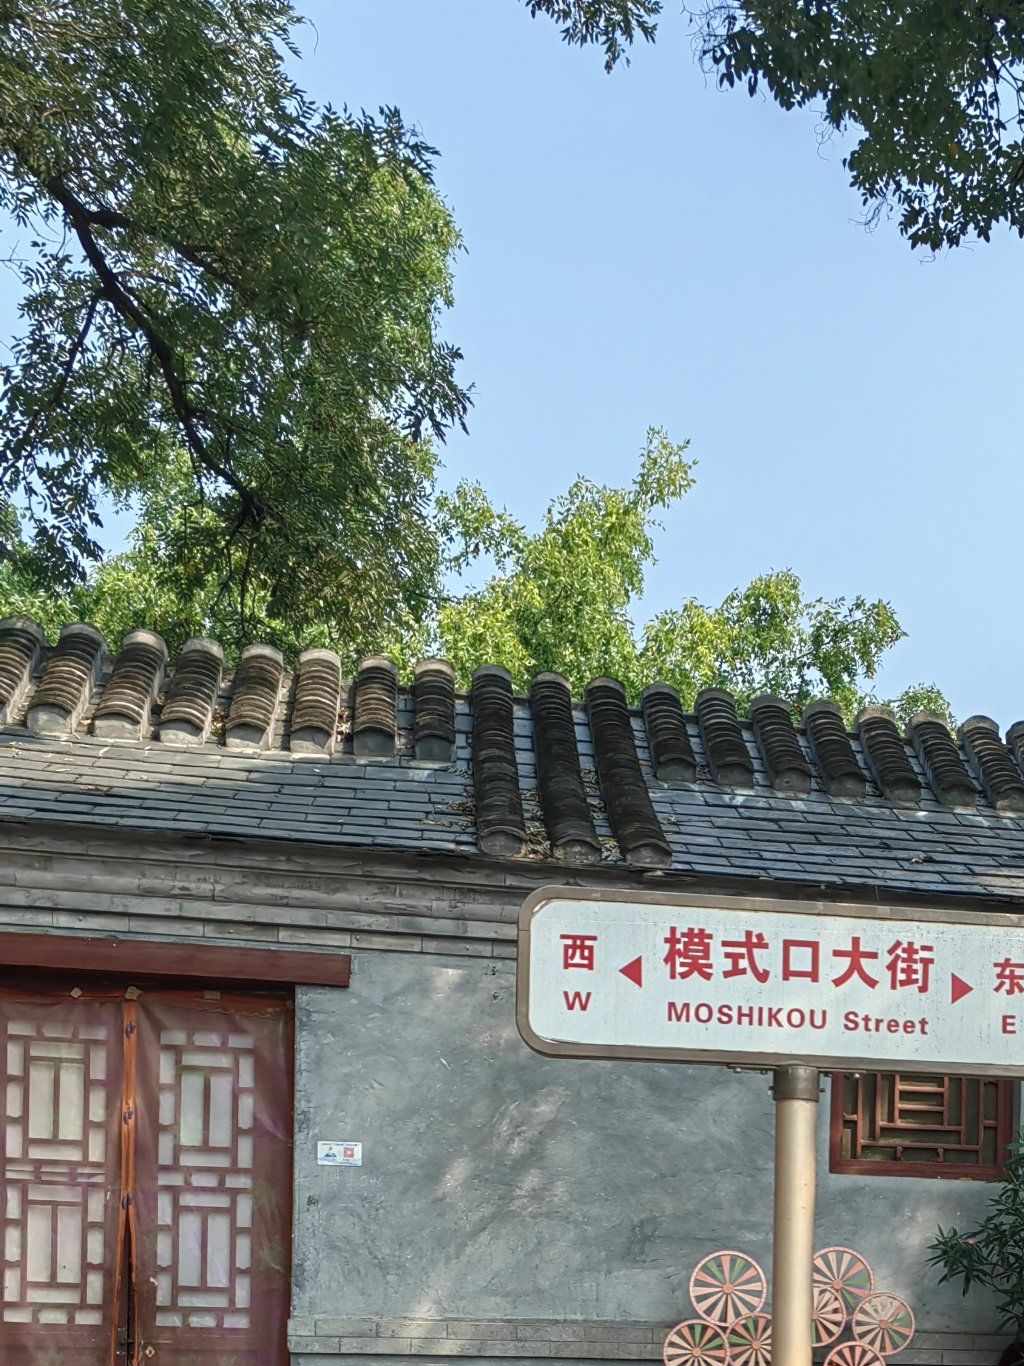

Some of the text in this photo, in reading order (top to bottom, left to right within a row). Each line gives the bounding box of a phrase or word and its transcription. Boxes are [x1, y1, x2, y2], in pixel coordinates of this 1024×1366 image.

[560, 934, 598, 971] 西
[663, 927, 935, 994] 模式口大街
[563, 991, 592, 1012] W
[667, 1002, 929, 1036] MOSHIKOU Street
[1001, 1015, 1017, 1035] E
